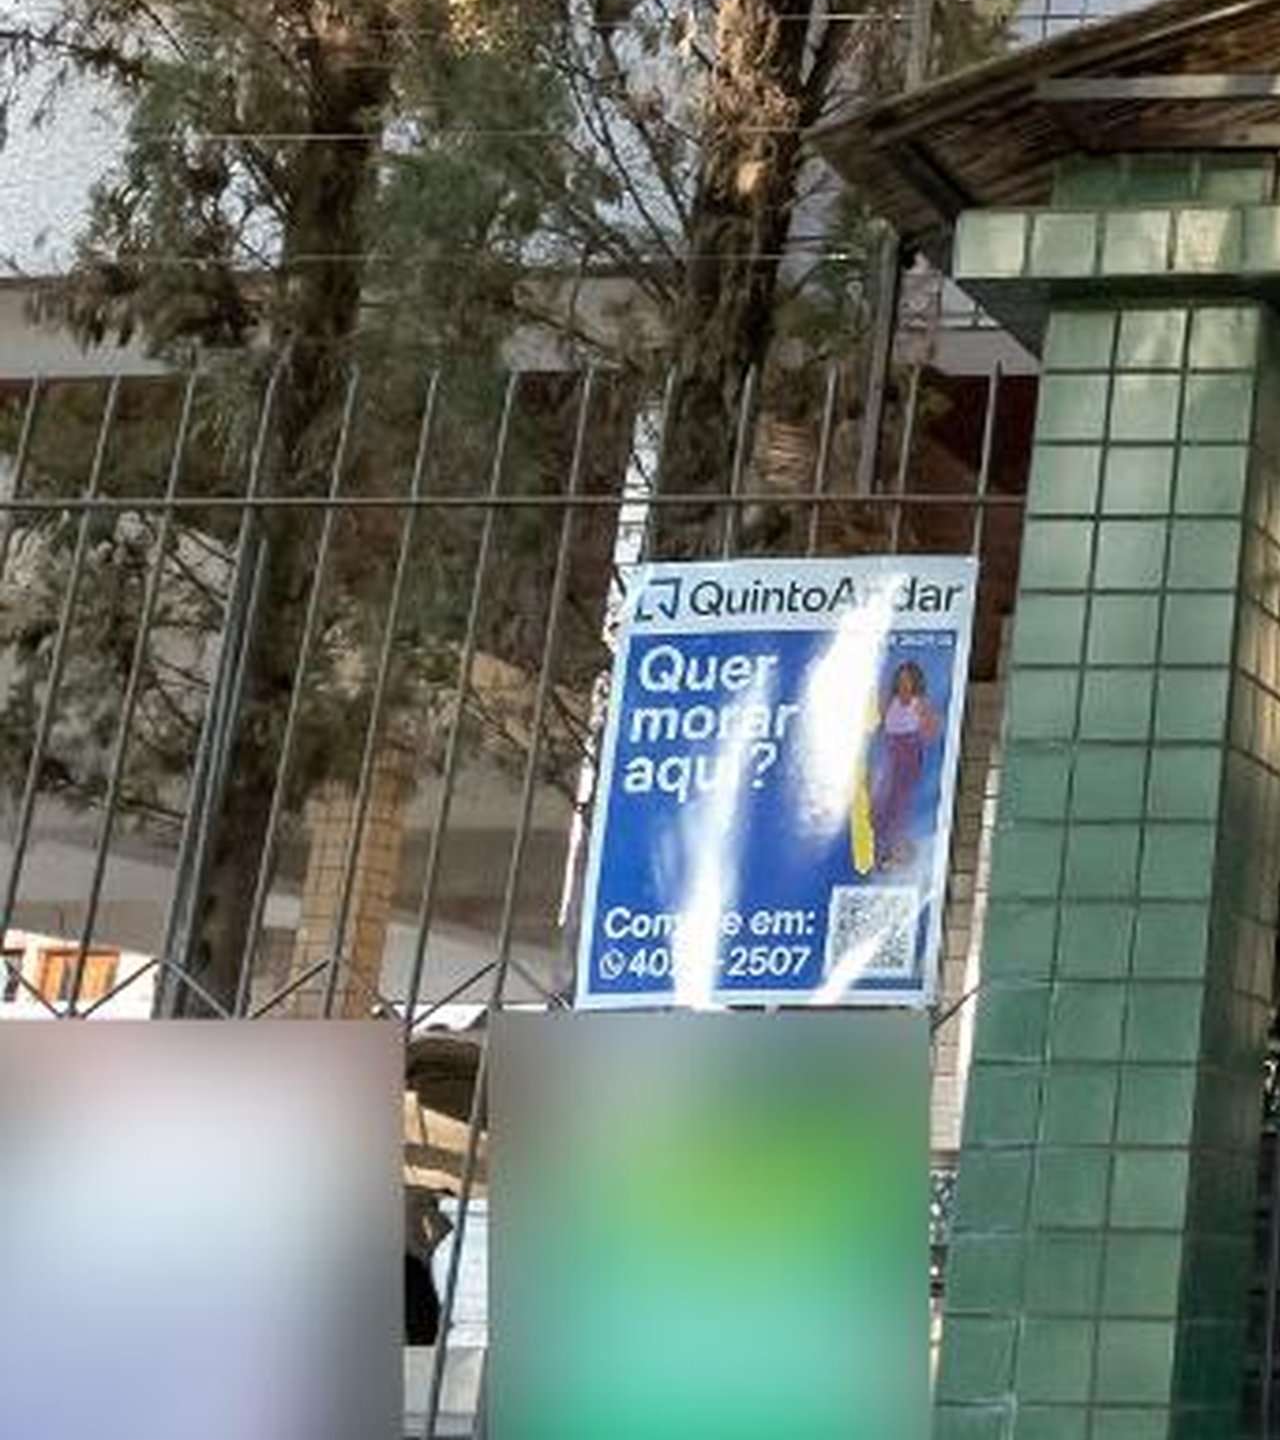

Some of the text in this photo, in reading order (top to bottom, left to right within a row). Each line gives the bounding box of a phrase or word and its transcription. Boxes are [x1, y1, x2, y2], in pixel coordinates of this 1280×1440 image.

[639, 645, 779, 694] Quer
[629, 702, 800, 743] morar
[750, 910, 816, 936] em:
[628, 945, 812, 978] 40-2507
